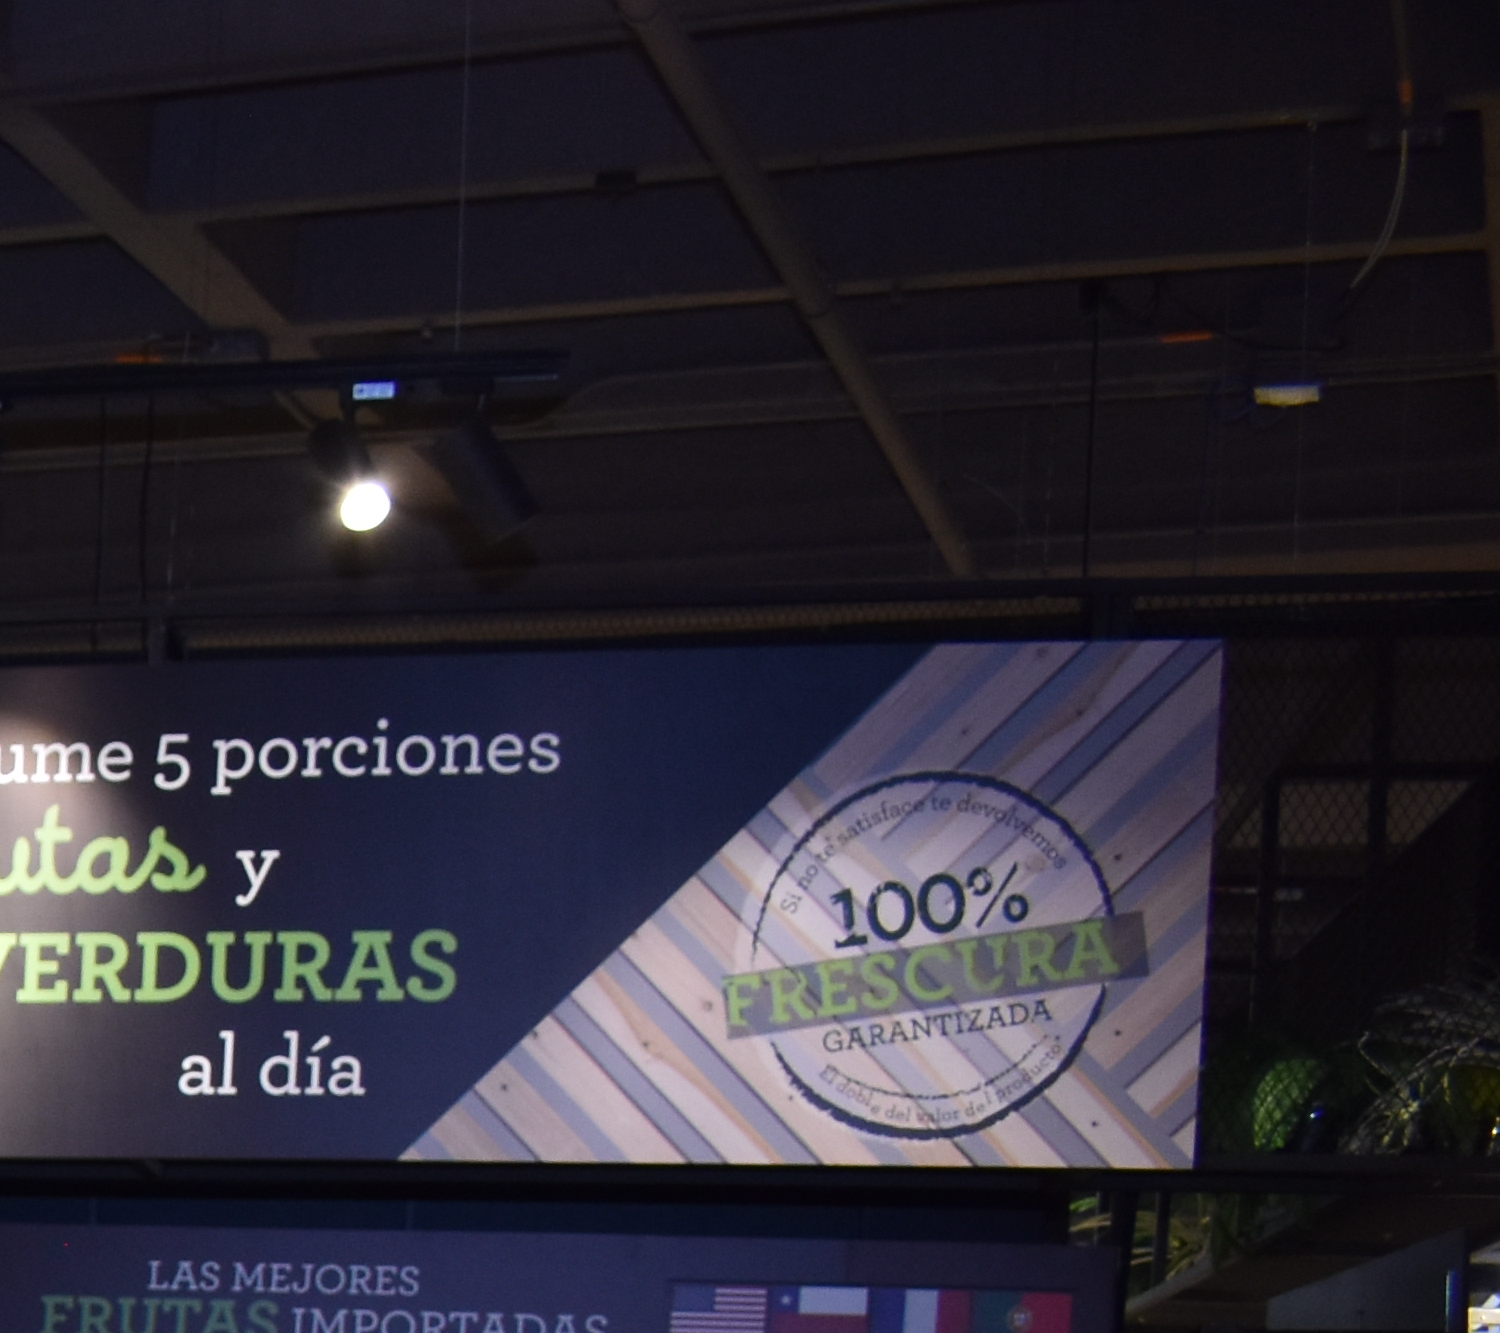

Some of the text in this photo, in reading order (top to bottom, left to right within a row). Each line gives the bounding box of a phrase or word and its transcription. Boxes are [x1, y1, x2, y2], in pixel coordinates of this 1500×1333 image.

[153, 728, 192, 787] 5
[211, 718, 562, 794] porciones
[234, 841, 281, 905] y
[780, 891, 799, 915] Si
[836, 796, 926, 848] satisface
[931, 794, 952, 812] te
[956, 794, 1067, 870] devolvemos
[829, 862, 1031, 949] 100%
[722, 920, 1120, 1027] FRESCURA
[822, 999, 1053, 1054] GARANTIZADA
[176, 1031, 367, 1099] al día
[884, 1102, 912, 1123] del
[147, 1259, 421, 1297] LAS MEJORES
